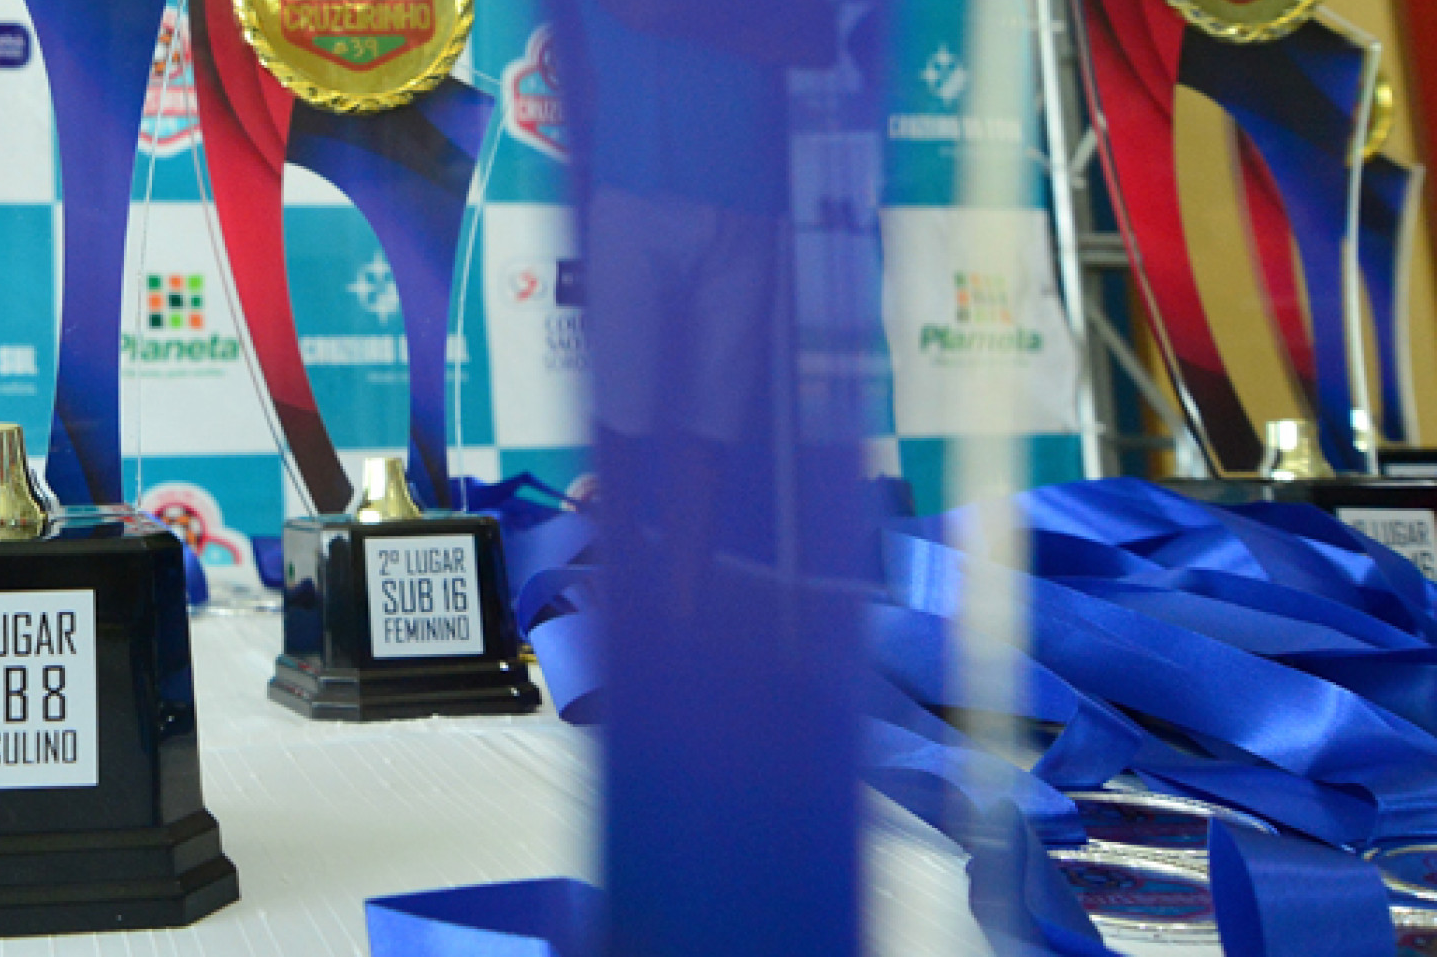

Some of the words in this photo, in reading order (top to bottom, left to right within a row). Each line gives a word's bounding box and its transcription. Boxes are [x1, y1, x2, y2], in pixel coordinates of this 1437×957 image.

[281, 2, 431, 33] CRUZEIRINHO
[378, 550, 401, 575] 2º
[405, 548, 466, 575] LUGAR
[382, 580, 434, 614] SUB
[442, 578, 468, 613] 16
[384, 615, 470, 644] FEMININO
[42, 664, 66, 722] 8
